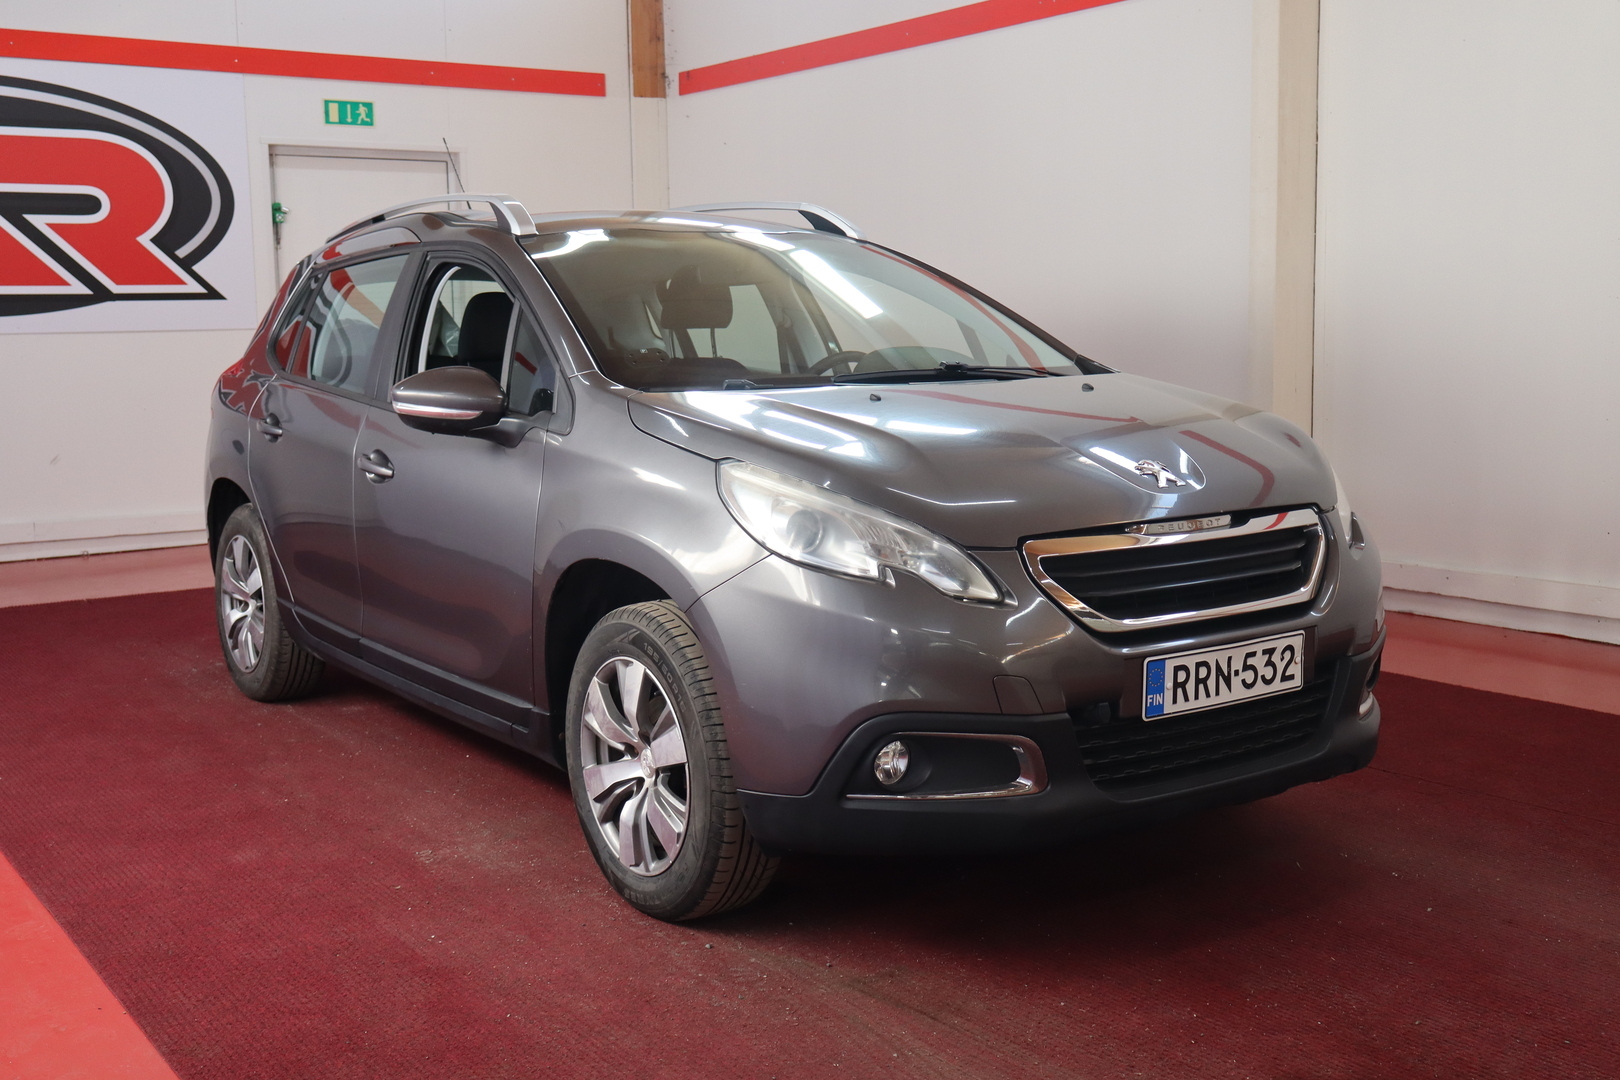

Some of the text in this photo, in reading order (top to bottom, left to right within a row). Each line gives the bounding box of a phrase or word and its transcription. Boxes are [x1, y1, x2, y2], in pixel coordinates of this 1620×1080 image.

[0, 126, 222, 299] R
[1157, 517, 1222, 532] PEUGEOT
[1171, 643, 1297, 705] RRN-532
[1146, 692, 1164, 708] FIN
